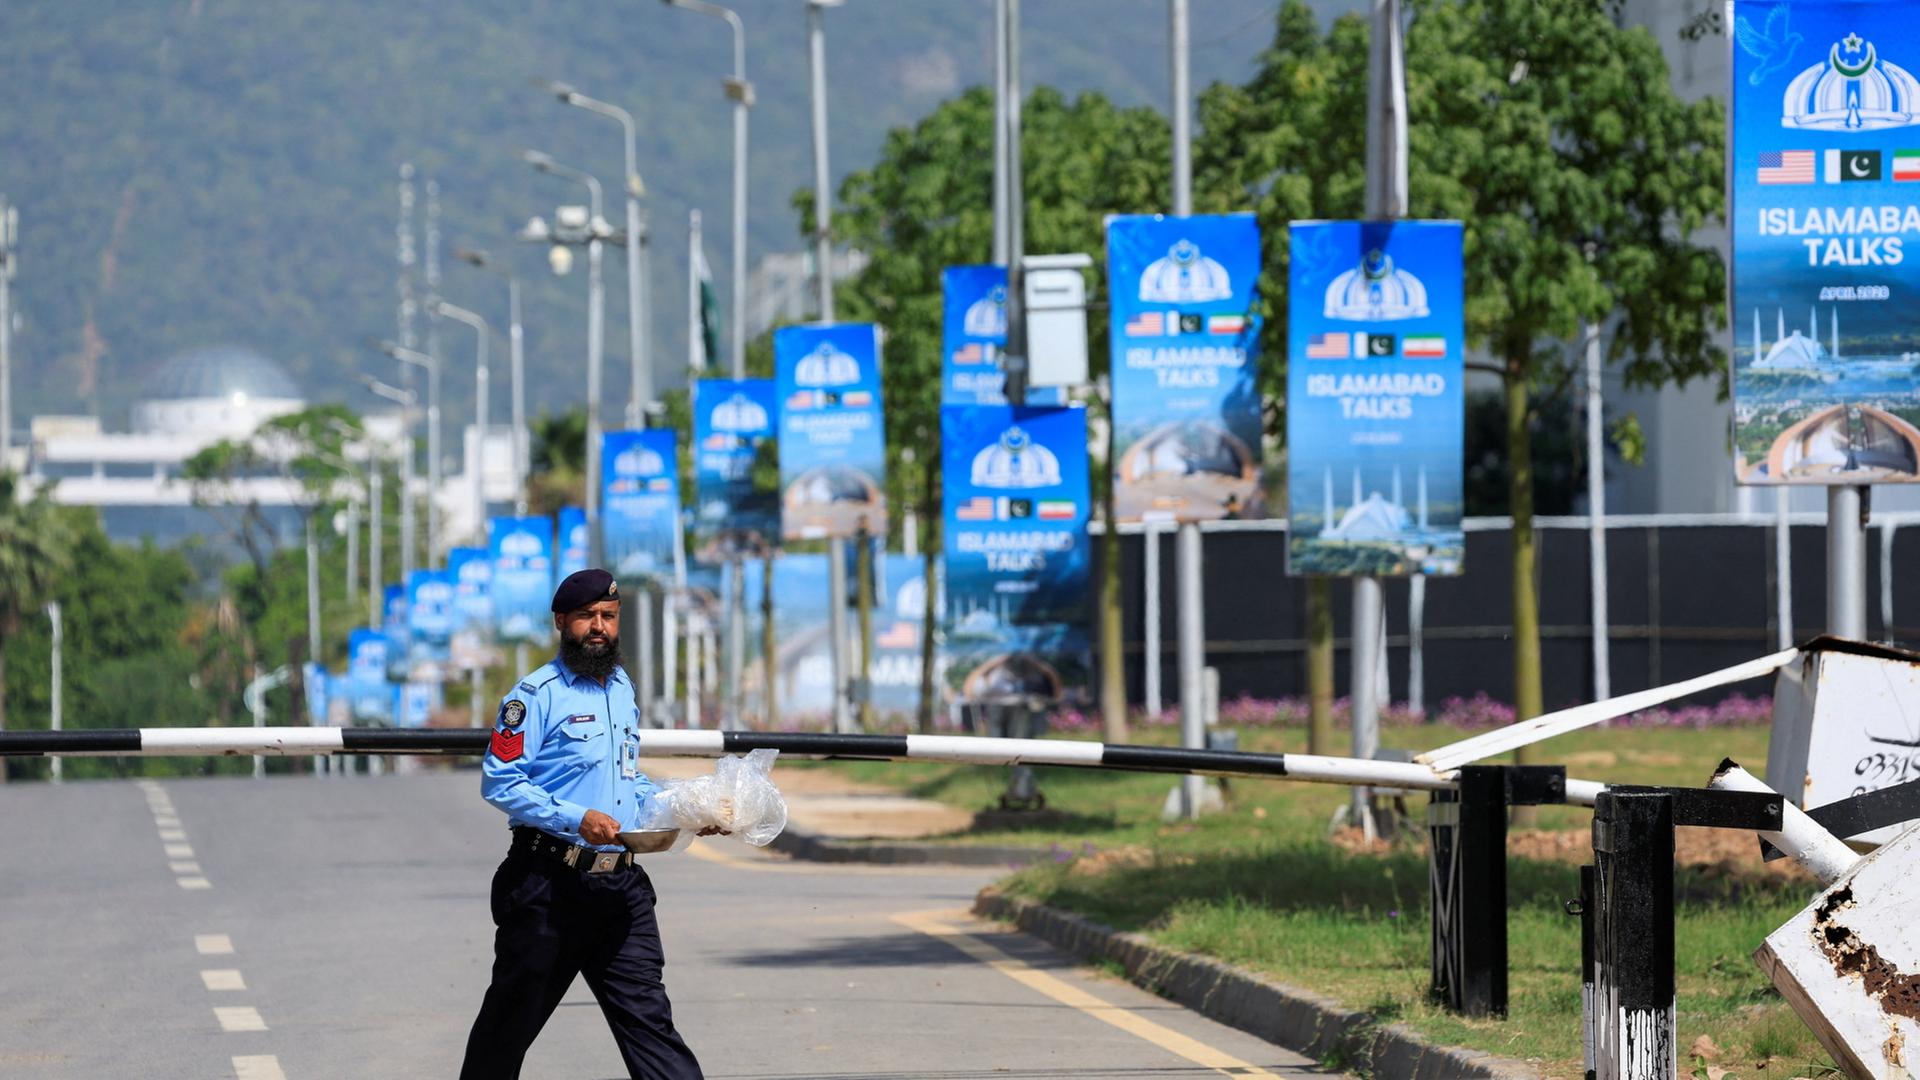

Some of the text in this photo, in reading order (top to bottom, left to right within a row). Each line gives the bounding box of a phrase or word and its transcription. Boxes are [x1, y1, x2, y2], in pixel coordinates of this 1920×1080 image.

[1759, 206, 1920, 235] ISLAMABA
[1803, 237, 1904, 266] TALKS
[1820, 286, 1856, 300] APRIL
[1307, 373, 1445, 396] ISLAMABAD
[1339, 397, 1413, 419] TALKS
